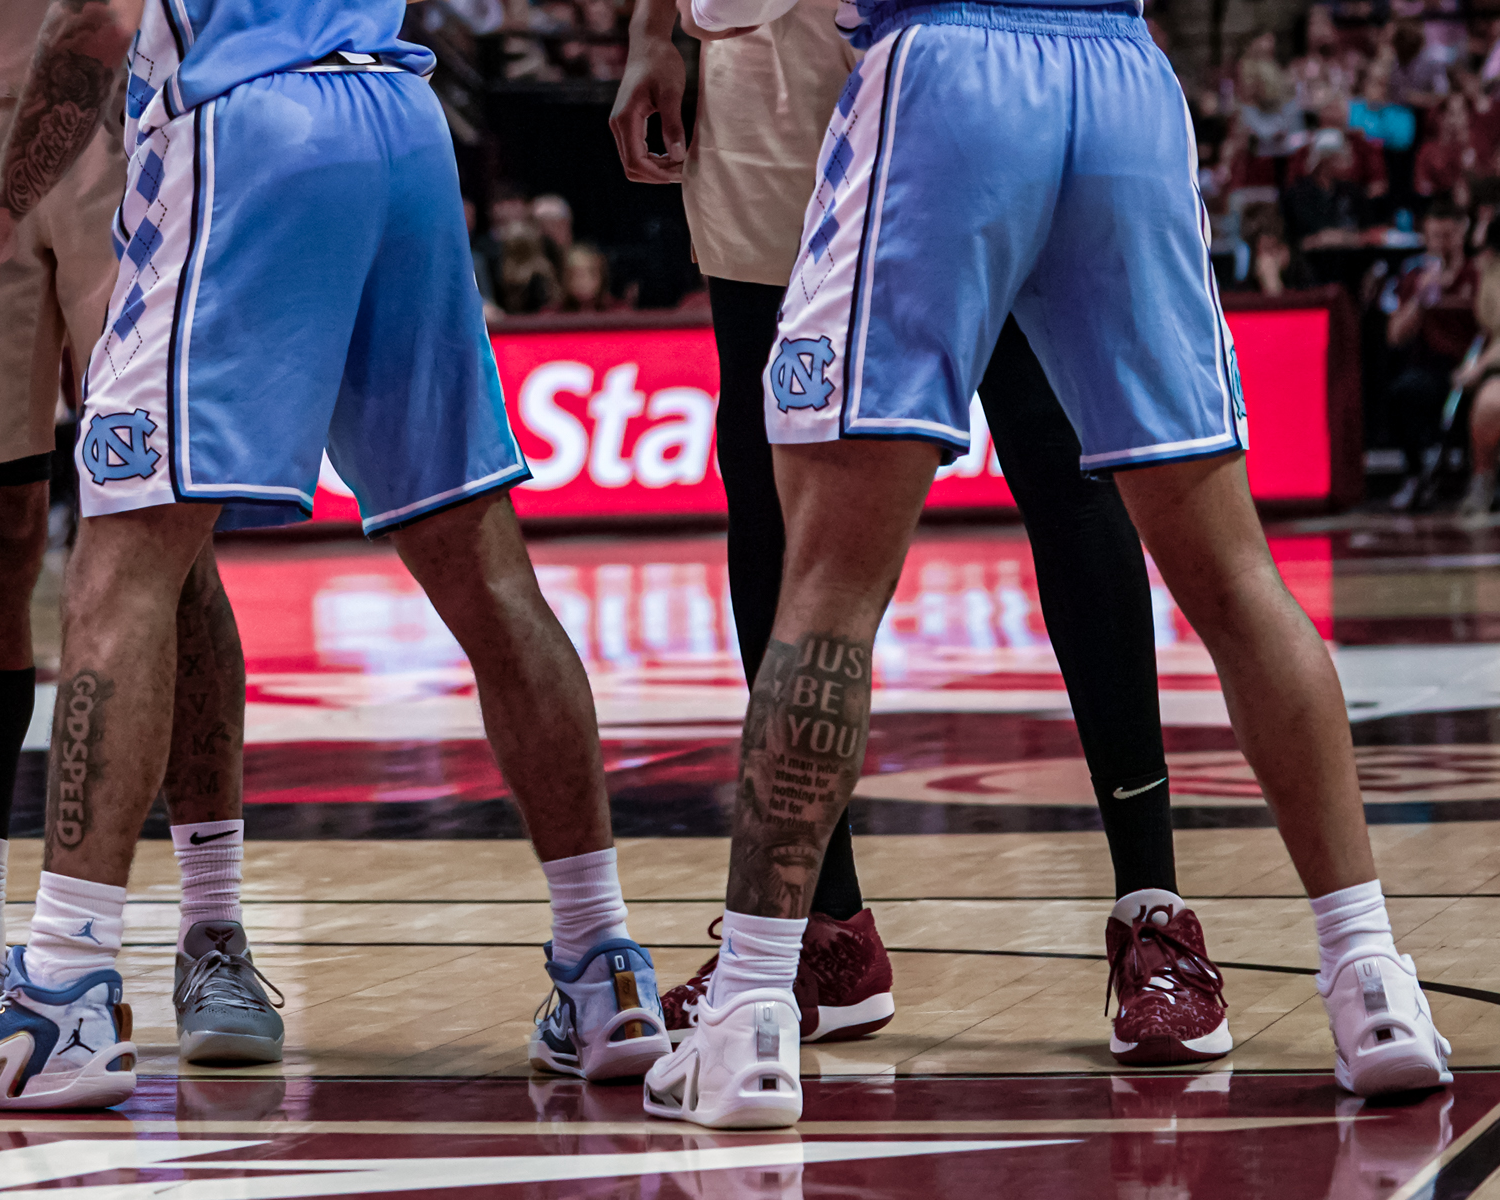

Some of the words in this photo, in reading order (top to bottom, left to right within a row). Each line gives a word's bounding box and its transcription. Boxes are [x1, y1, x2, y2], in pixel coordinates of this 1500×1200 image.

[518, 361, 722, 490] Sta
[797, 639, 869, 682] JUS
[792, 674, 843, 714] BE
[788, 714, 858, 758] YOU
[56, 674, 97, 846] GODSPEED
